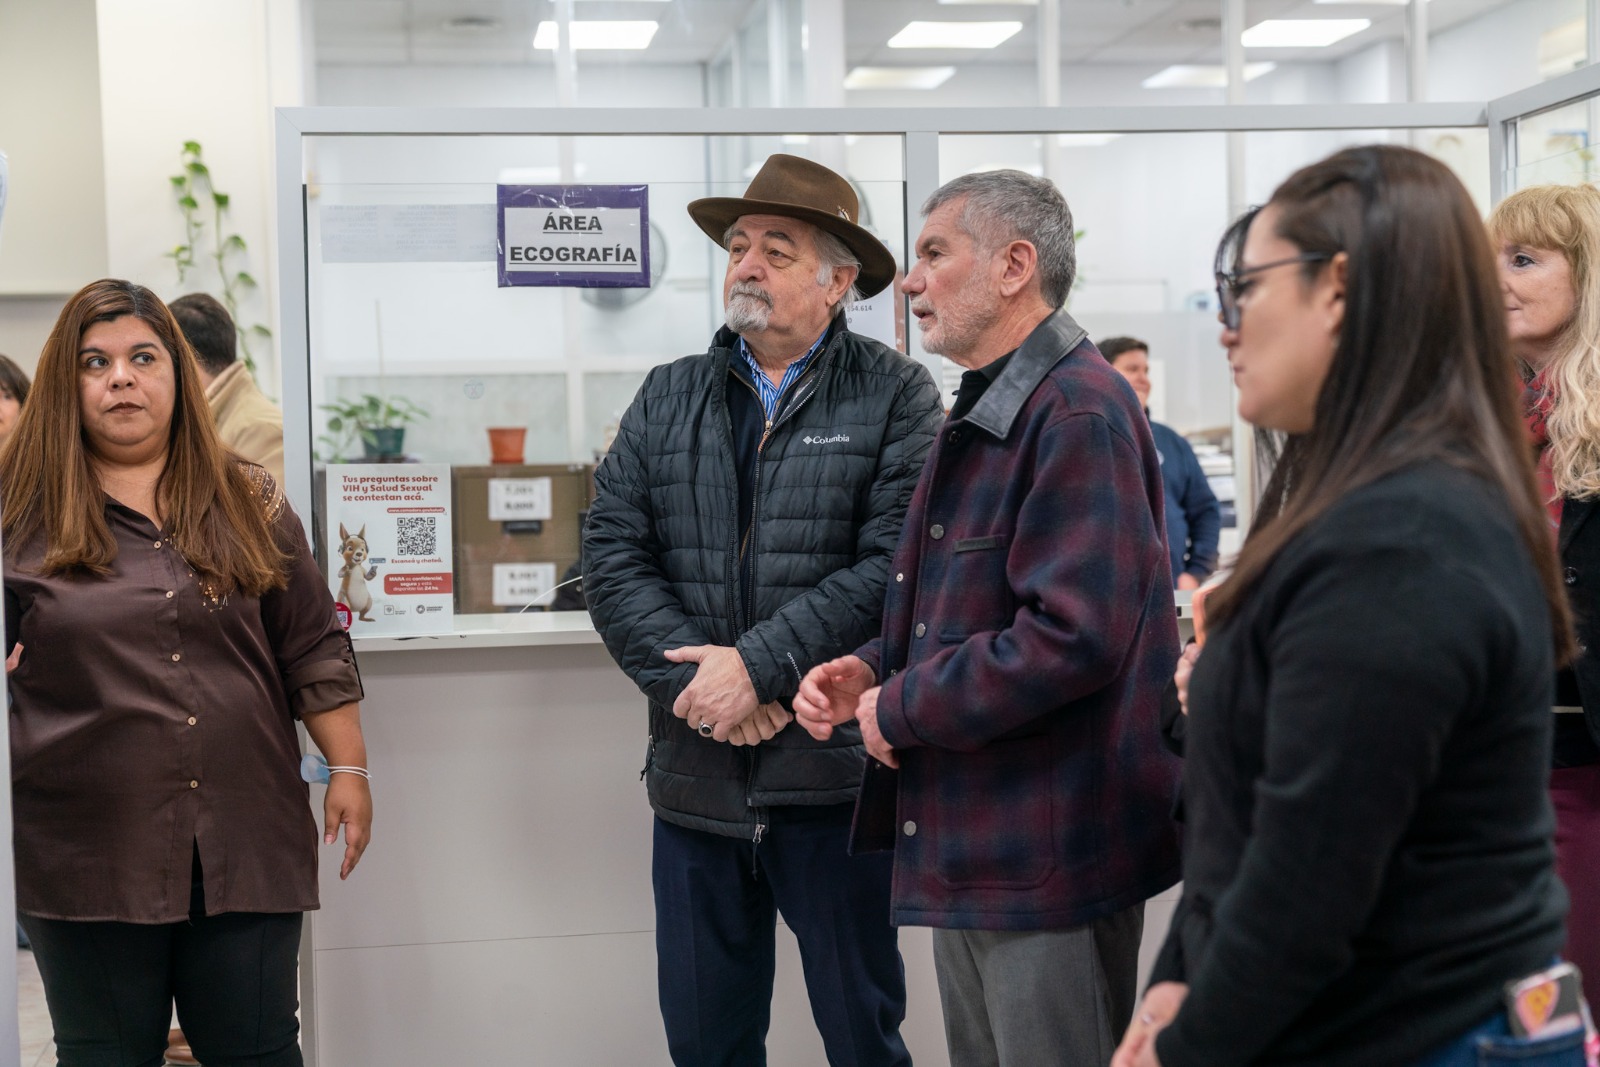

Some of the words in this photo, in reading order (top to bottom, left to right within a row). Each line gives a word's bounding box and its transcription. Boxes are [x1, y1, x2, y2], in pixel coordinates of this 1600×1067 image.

[543, 212, 603, 231] ÁREA
[510, 244, 637, 262] ECOGRAFÍA
[812, 434, 850, 444] Columbia
[342, 475, 358, 483] Tus
[359, 475, 410, 484] preguntas
[361, 486, 368, 494] y
[370, 484, 399, 492] Salud
[403, 492, 425, 501] acá.
